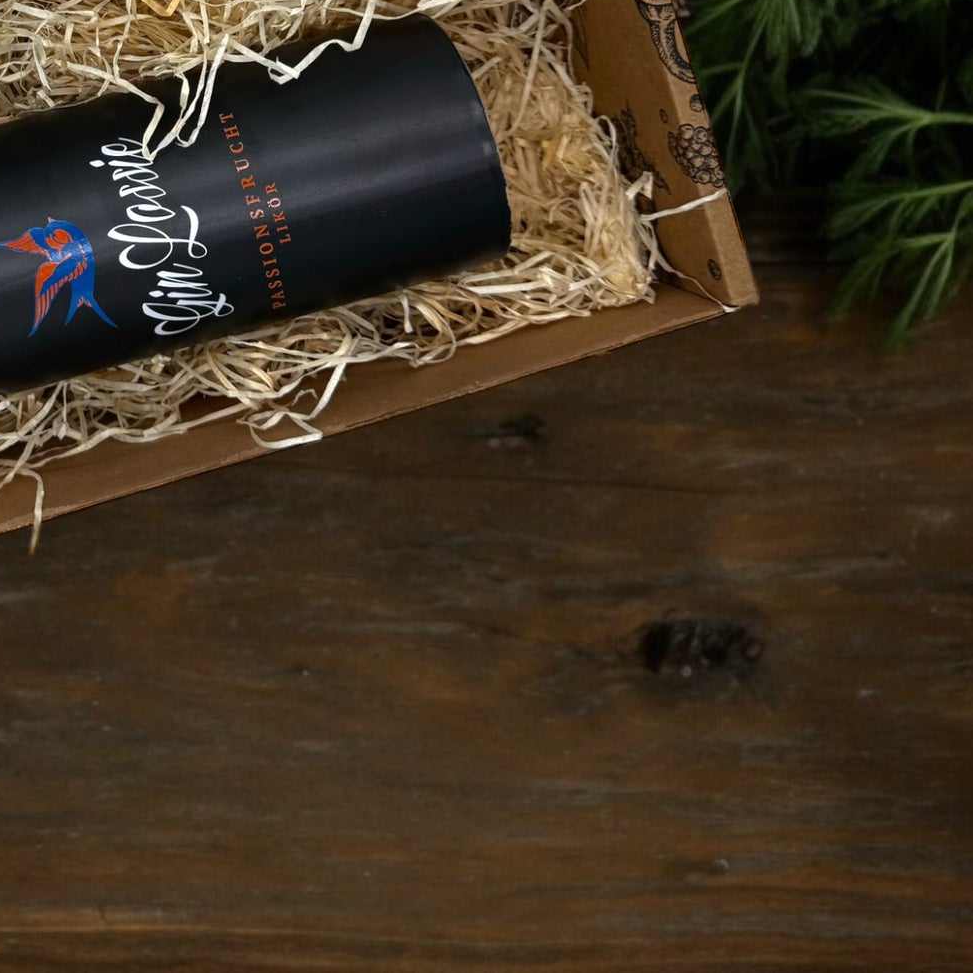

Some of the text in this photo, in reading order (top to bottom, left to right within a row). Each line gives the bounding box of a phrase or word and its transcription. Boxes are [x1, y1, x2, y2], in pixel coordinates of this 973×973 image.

[219, 112, 287, 310] PASSIONSFRUCHT
[264, 182, 292, 244] LIKÖR
[142, 262, 235, 336] Gin
